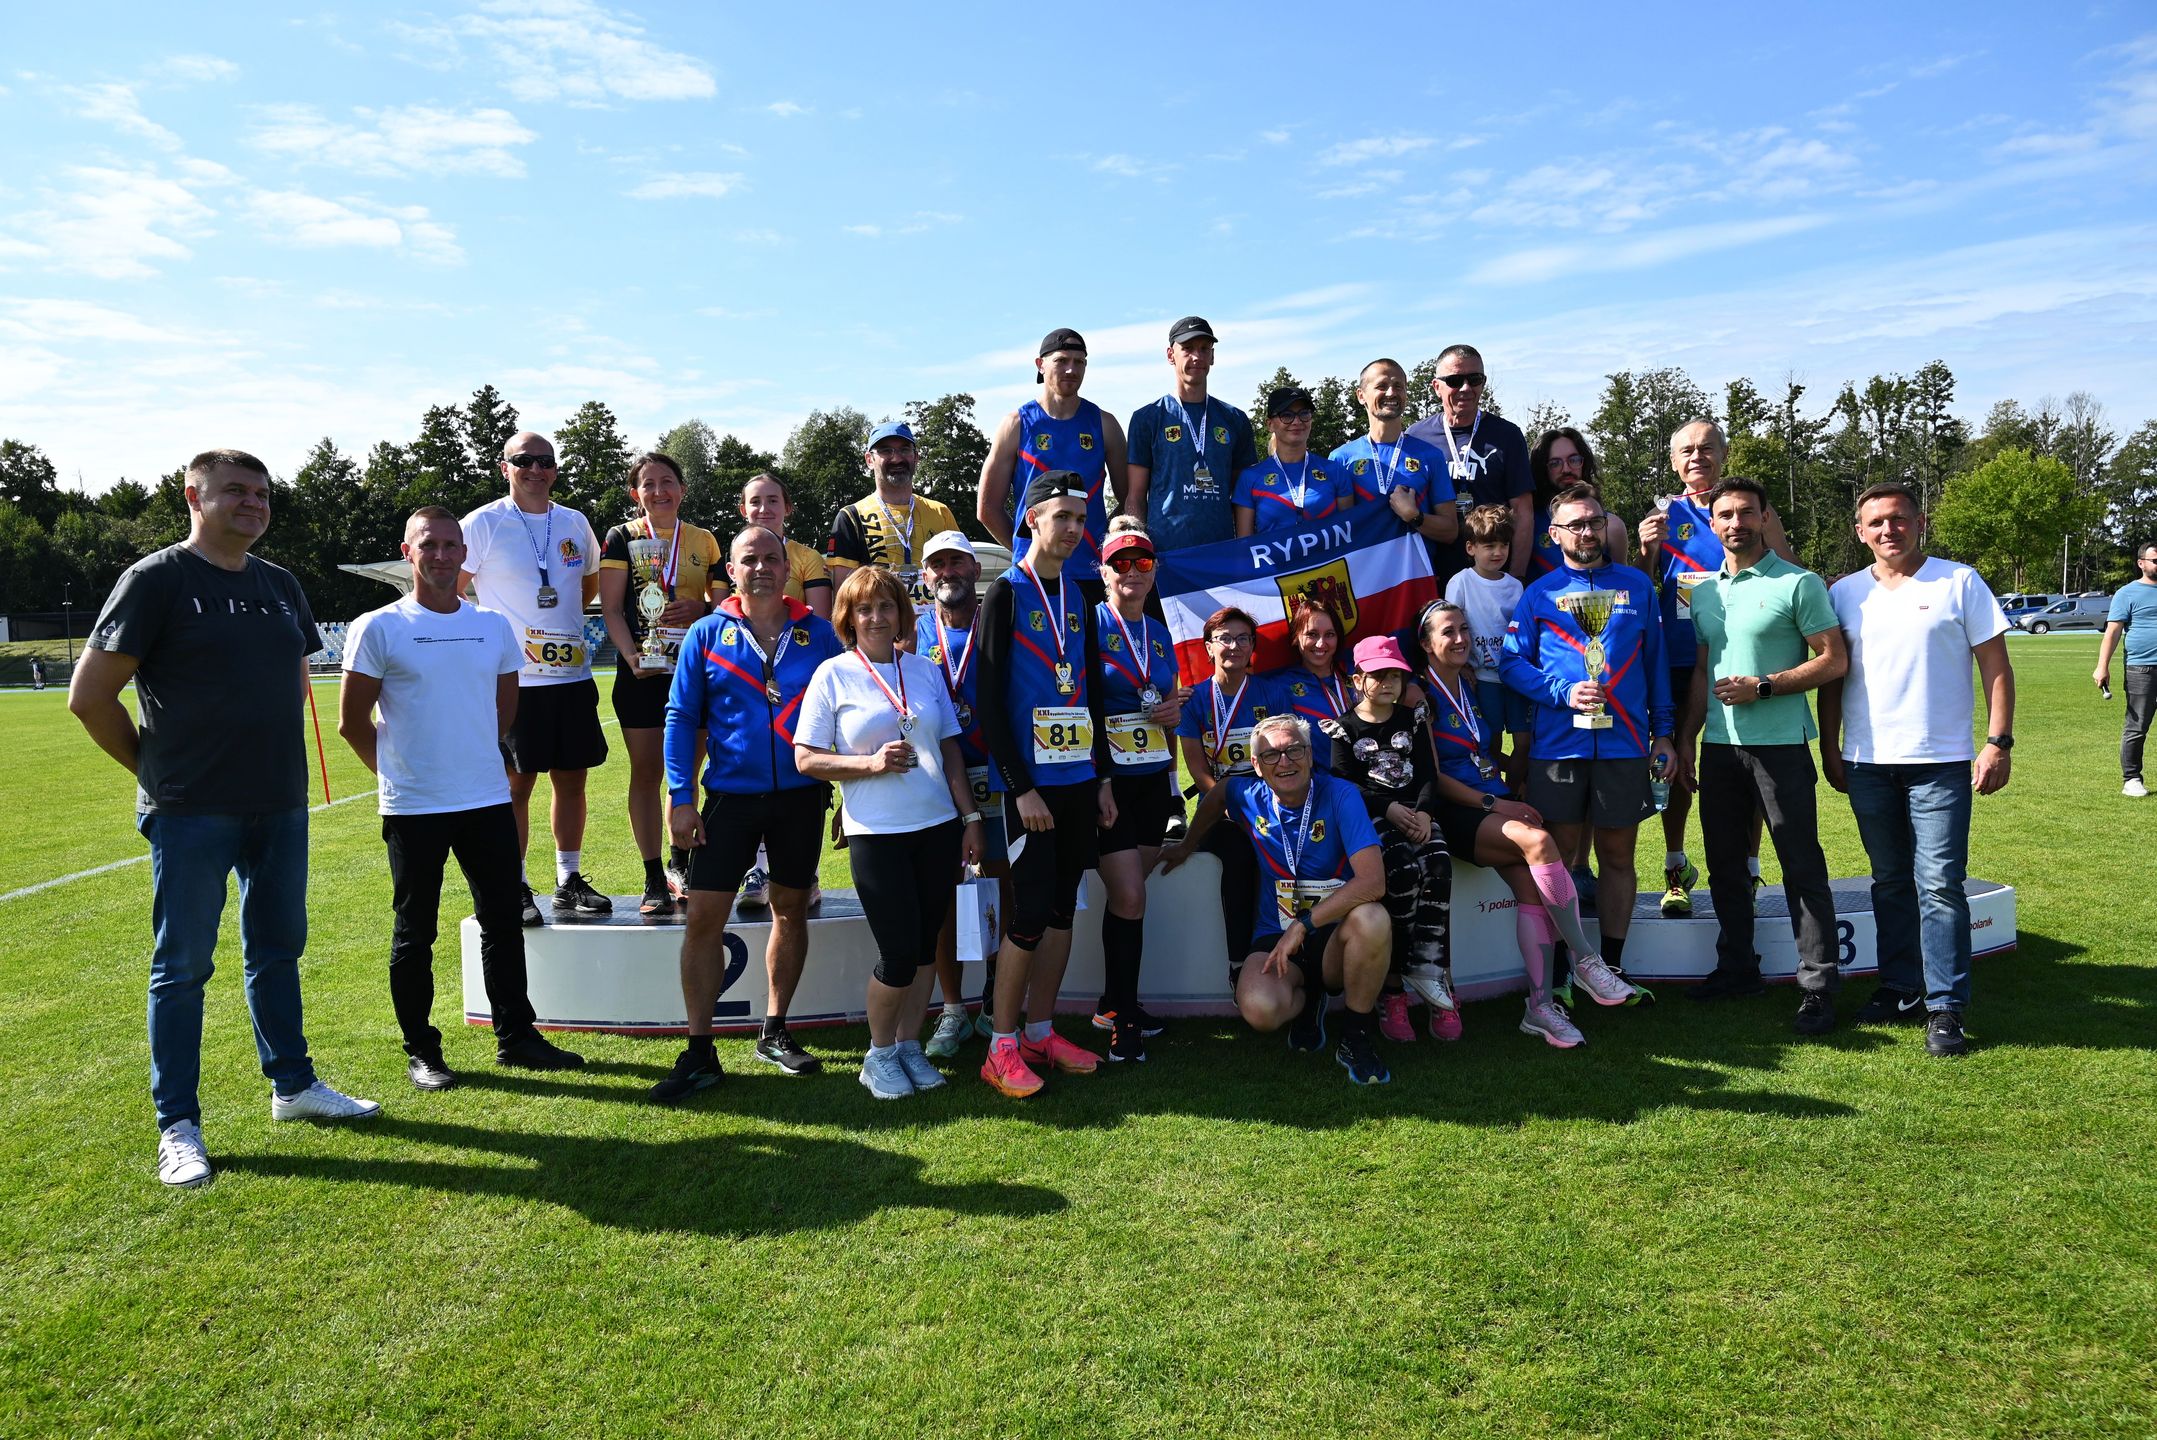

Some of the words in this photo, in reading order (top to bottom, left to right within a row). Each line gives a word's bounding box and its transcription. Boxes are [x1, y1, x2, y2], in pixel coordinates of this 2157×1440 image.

[1249, 521, 1352, 569] RYPIN
[1611, 607, 1638, 616] STRUKTOR
[541, 642, 573, 663] 63
[1050, 723, 1080, 746] 81
[1132, 728, 1149, 748] 9
[1228, 743, 1245, 762] 6
[1836, 920, 1857, 966] 3
[714, 932, 751, 1017] 2
